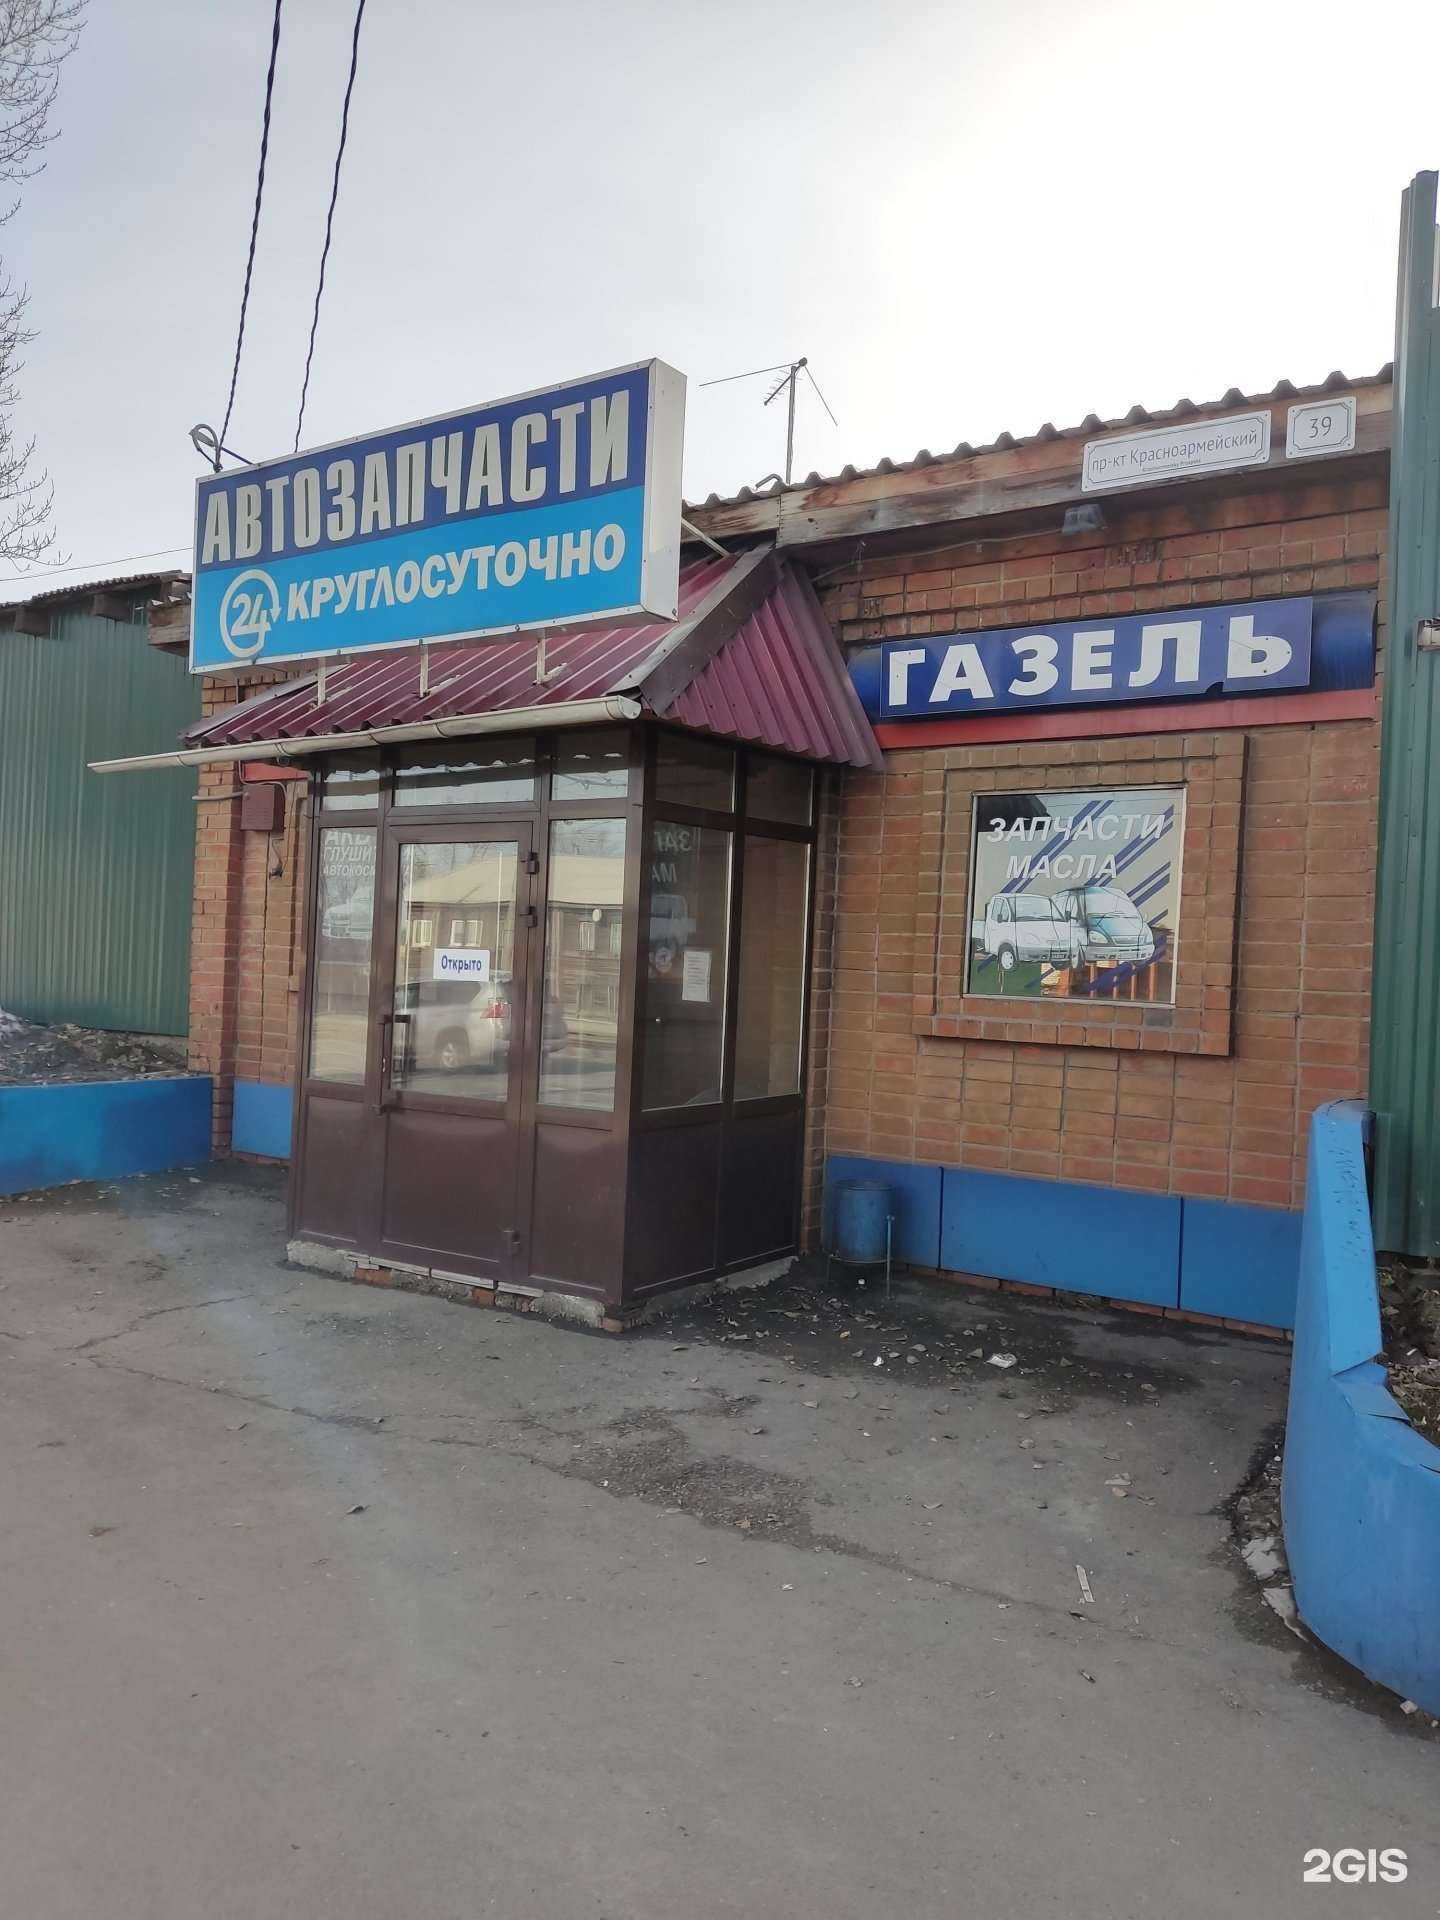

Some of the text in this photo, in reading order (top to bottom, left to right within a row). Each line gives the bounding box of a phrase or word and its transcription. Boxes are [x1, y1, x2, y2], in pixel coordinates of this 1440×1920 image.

[1308, 415, 1333, 438] 39
[1092, 454, 1127, 473] пр-кт
[1130, 430, 1258, 467] Красноармейский
[202, 390, 629, 564] АВТОЗАПЧАСТИ
[230, 523, 626, 645] 24 КРУГЛОСУТОЧНО
[888, 614, 1293, 707] ГАЗЕЛЬ
[986, 814, 1166, 843] ЗАПЧАСТИ
[1006, 854, 1117, 880] МАСЛА
[441, 954, 482, 974] Открыто
